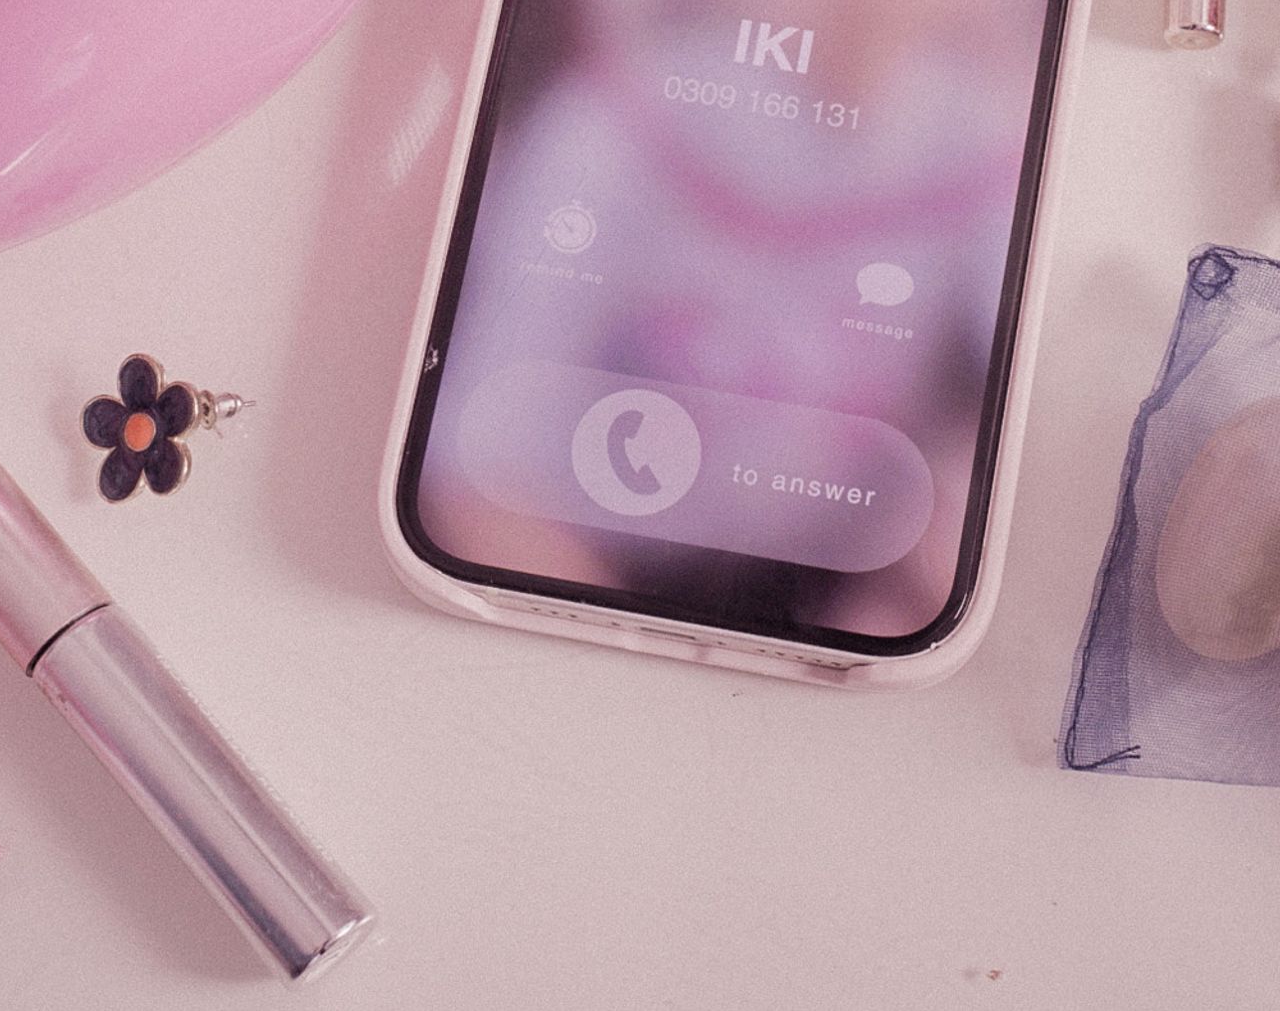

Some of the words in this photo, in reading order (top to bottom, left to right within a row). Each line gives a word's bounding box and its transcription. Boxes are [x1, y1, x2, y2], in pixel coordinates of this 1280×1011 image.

[733, 18, 816, 74] IKI
[663, 76, 737, 110] 0309
[750, 89, 800, 121] 166
[811, 100, 862, 131] 131
[579, 271, 605, 285] me
[840, 316, 915, 341] message
[732, 463, 759, 487] to
[770, 469, 878, 509] answer
